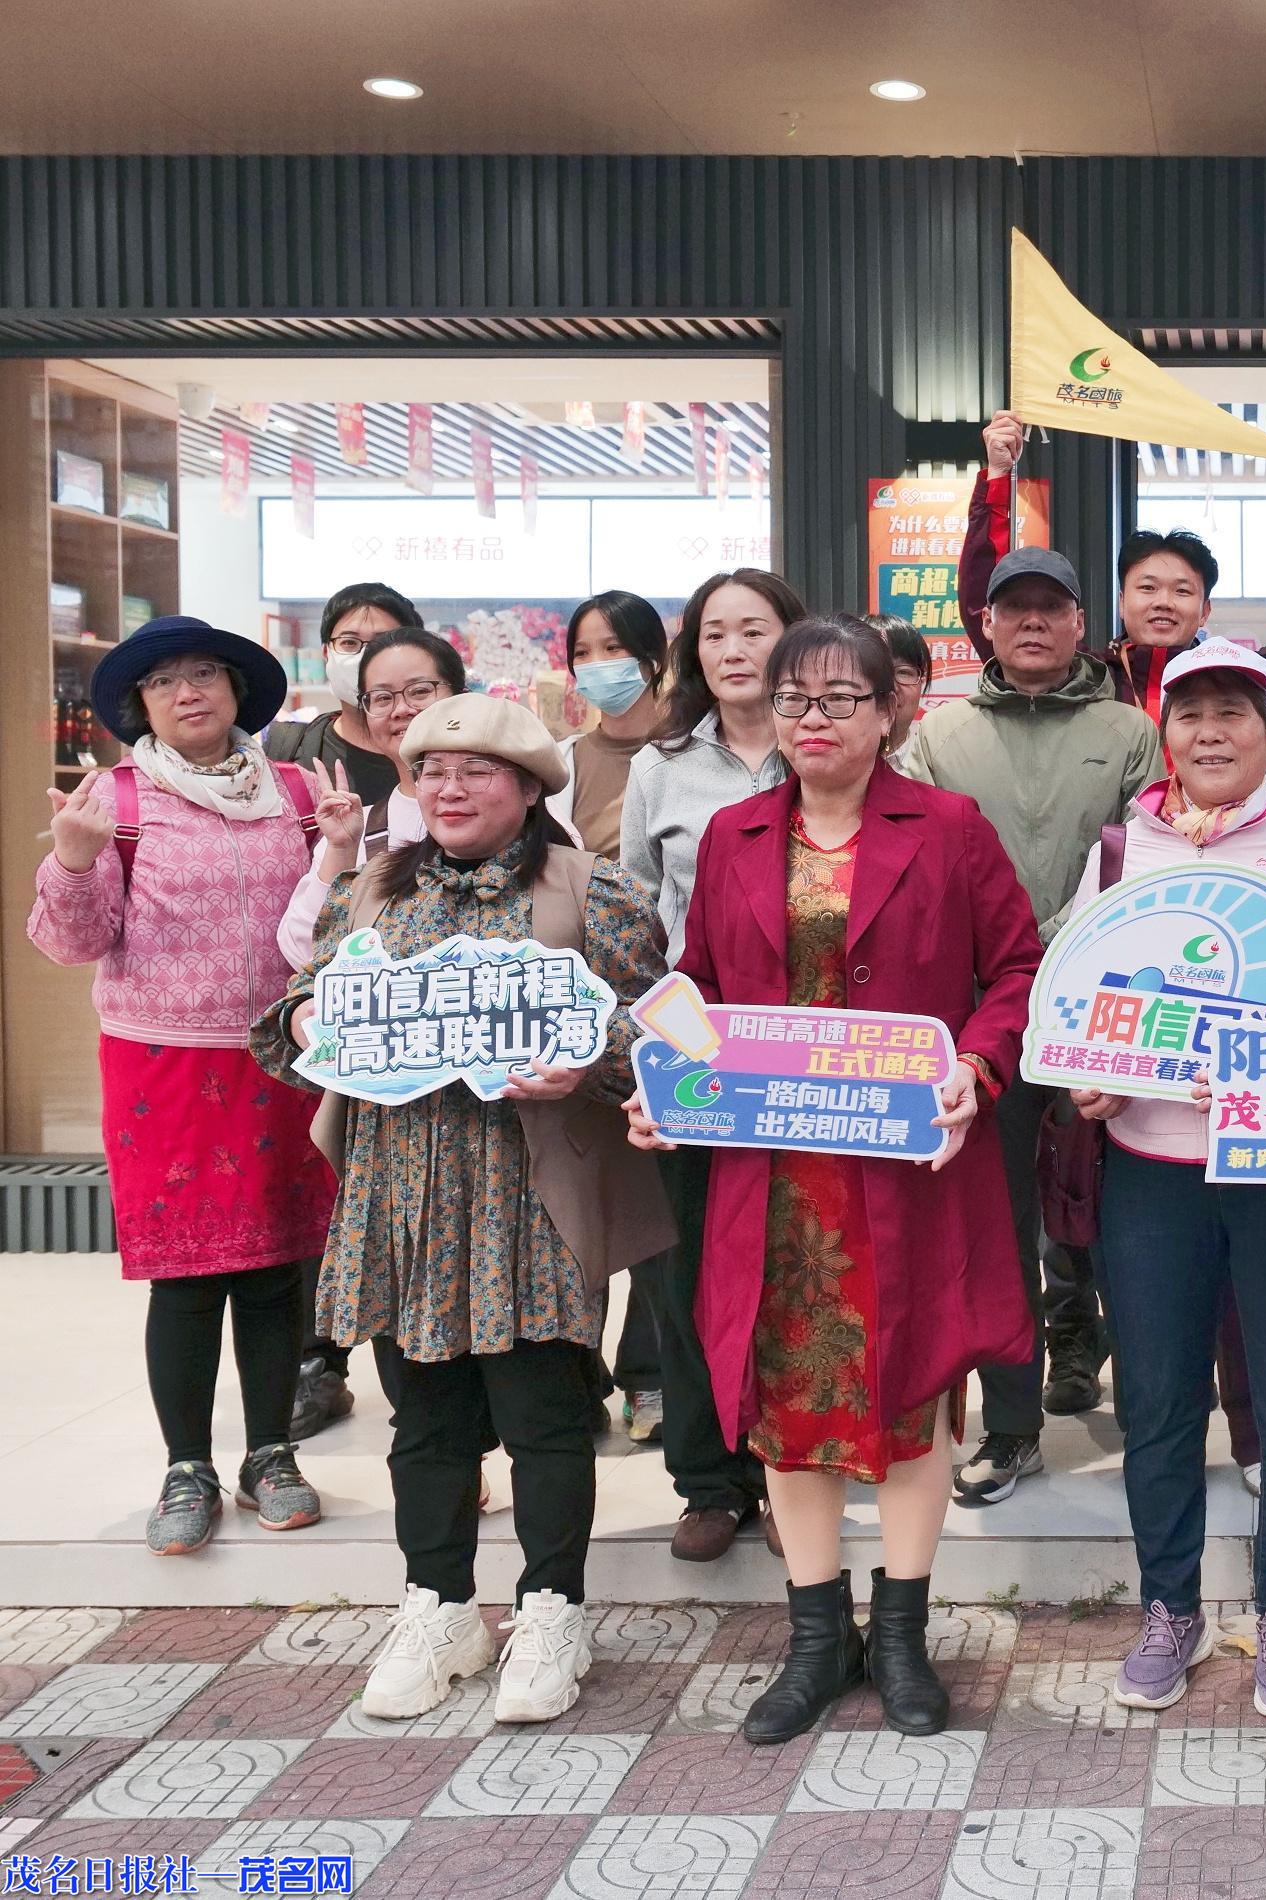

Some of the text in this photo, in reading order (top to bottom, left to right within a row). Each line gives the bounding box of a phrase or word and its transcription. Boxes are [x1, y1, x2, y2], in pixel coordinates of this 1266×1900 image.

[395, 537, 503, 560] 新禧有品
[927, 640, 982, 661] 真会
[322, 957, 576, 1025] 阳信启新程
[336, 1008, 596, 1076] 高速联山海
[805, 1046, 941, 1081] 正式通车
[1039, 1043, 1211, 1082] 赶紧去信宜看美
[735, 1080, 892, 1114] 一路向山海
[753, 1110, 910, 1147] 出发即风景
